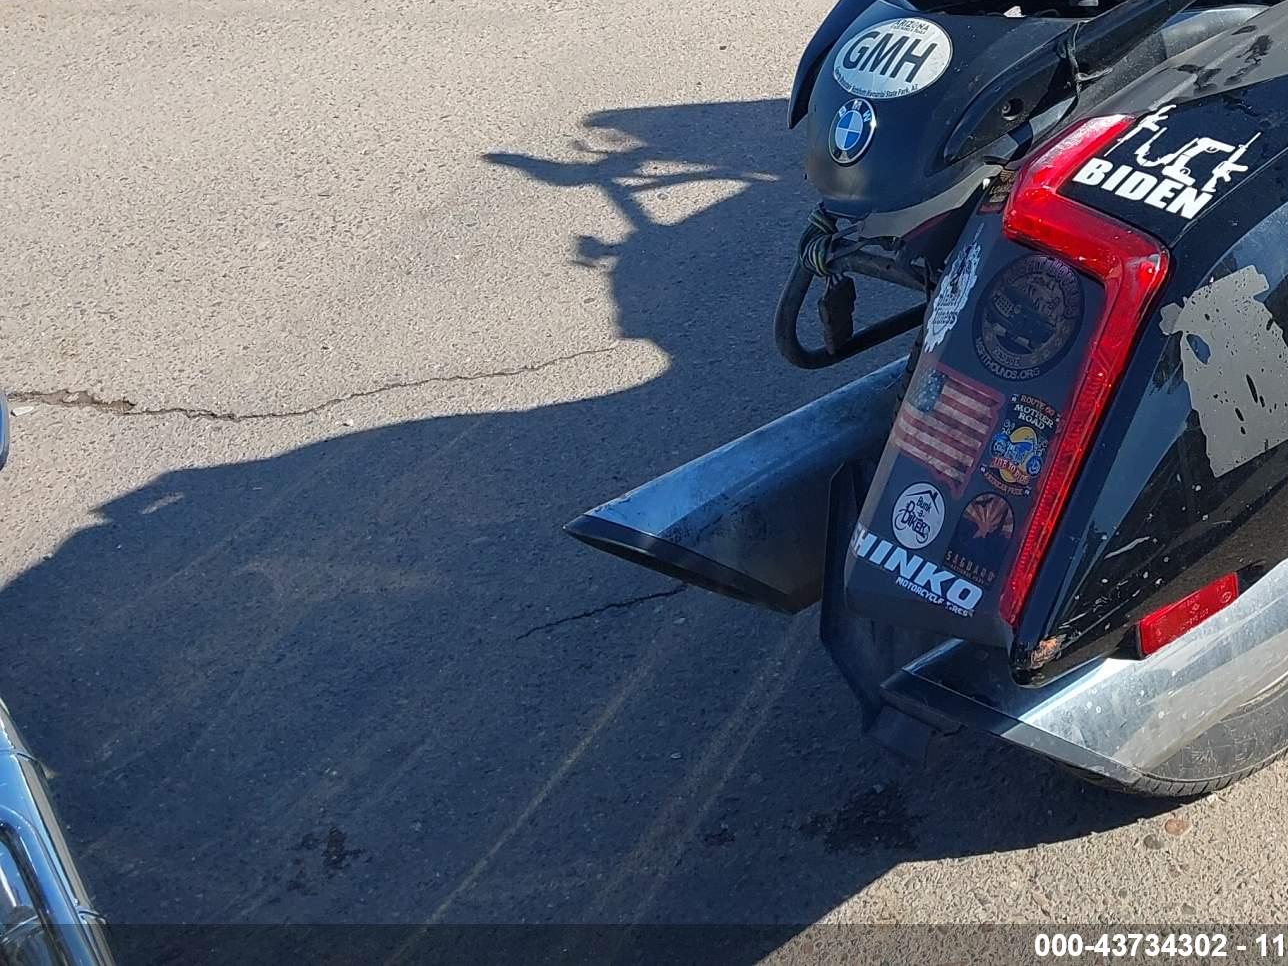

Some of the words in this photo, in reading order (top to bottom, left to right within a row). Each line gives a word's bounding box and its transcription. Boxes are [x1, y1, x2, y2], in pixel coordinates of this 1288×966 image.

[842, 30, 938, 84] GMH
[838, 99, 872, 122] BMW
[1072, 157, 1213, 220] BIDEN
[1020, 394, 1046, 411] ROUTE
[1013, 404, 1054, 429] MOTHER
[1018, 413, 1046, 430] ROAD
[895, 576, 945, 605] MOTORCYCLE
